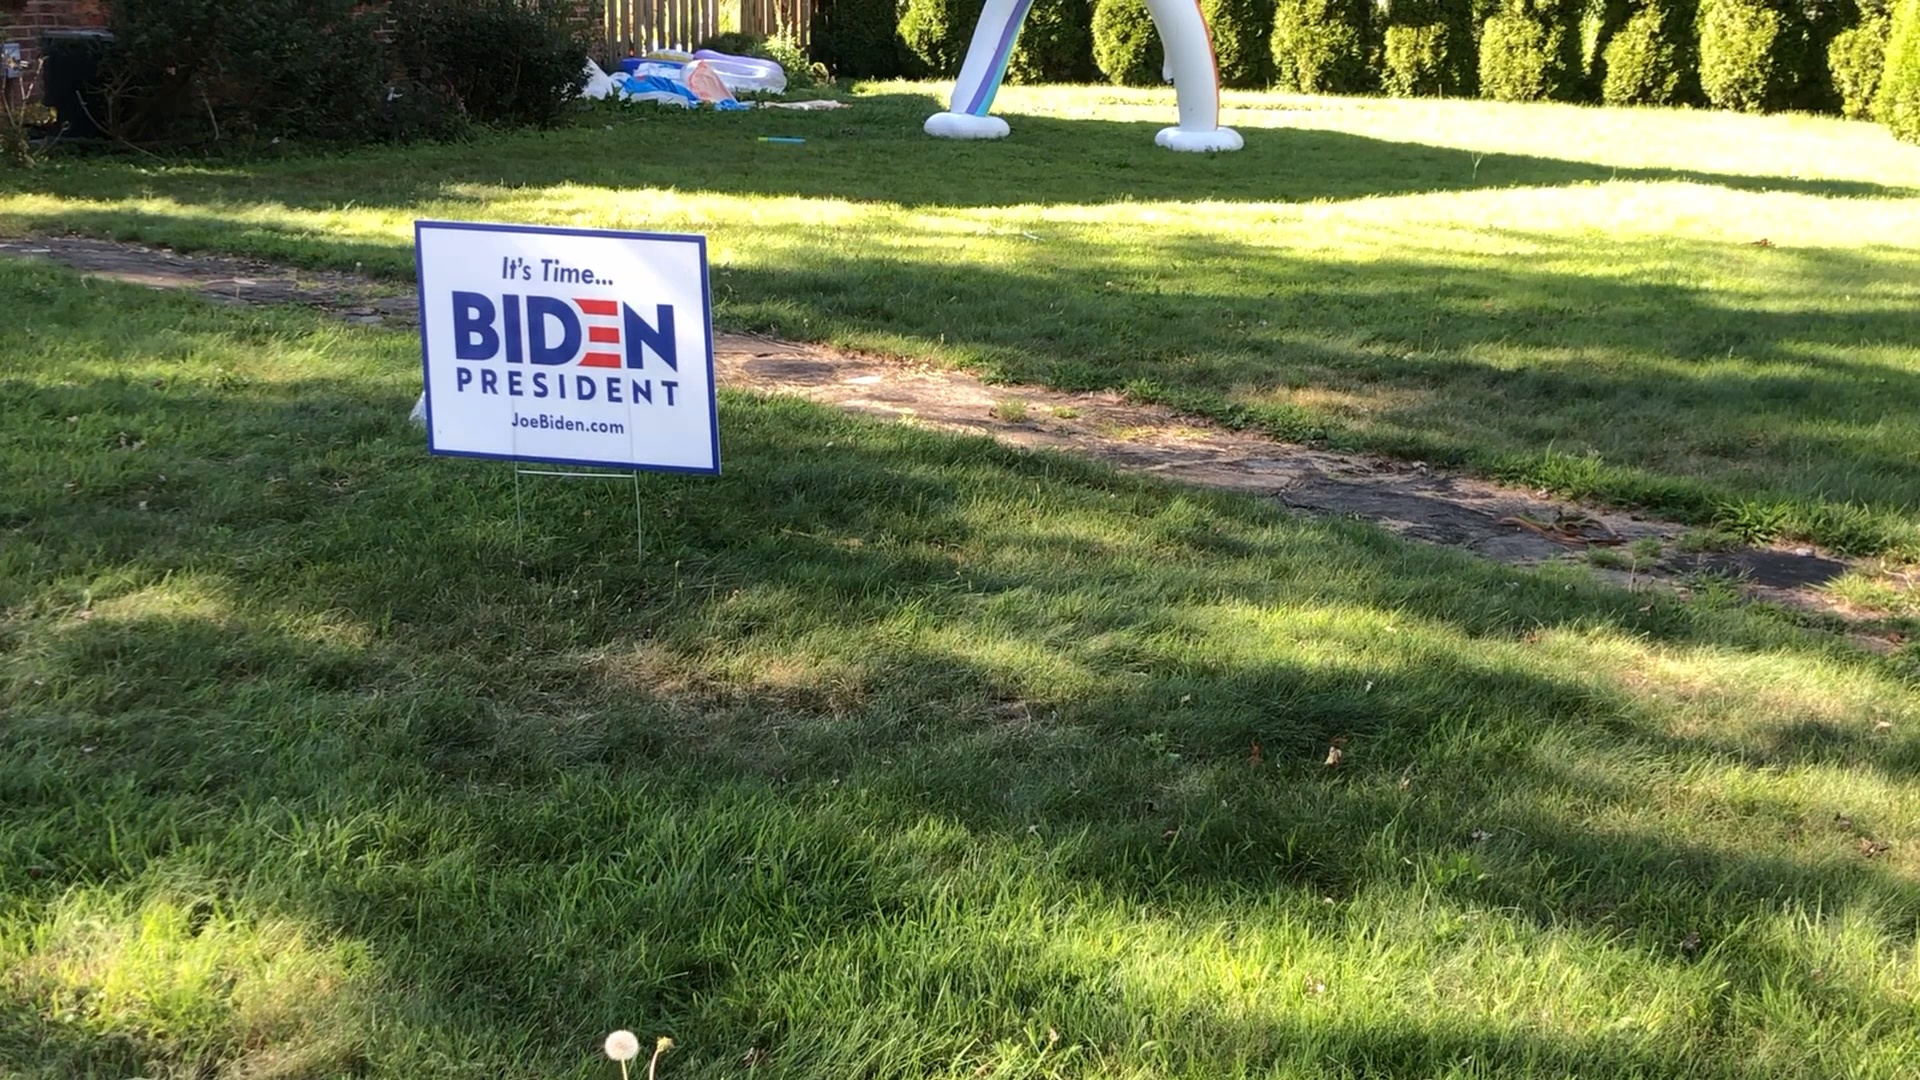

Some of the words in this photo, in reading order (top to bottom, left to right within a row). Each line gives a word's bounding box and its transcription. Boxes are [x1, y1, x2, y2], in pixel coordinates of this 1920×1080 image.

[502, 256, 532, 281] It's
[541, 258, 614, 286] Time...
[451, 290, 678, 373] BIDEN
[456, 367, 678, 406] PRESIDENT
[511, 412, 624, 434] JoeBiden.com
